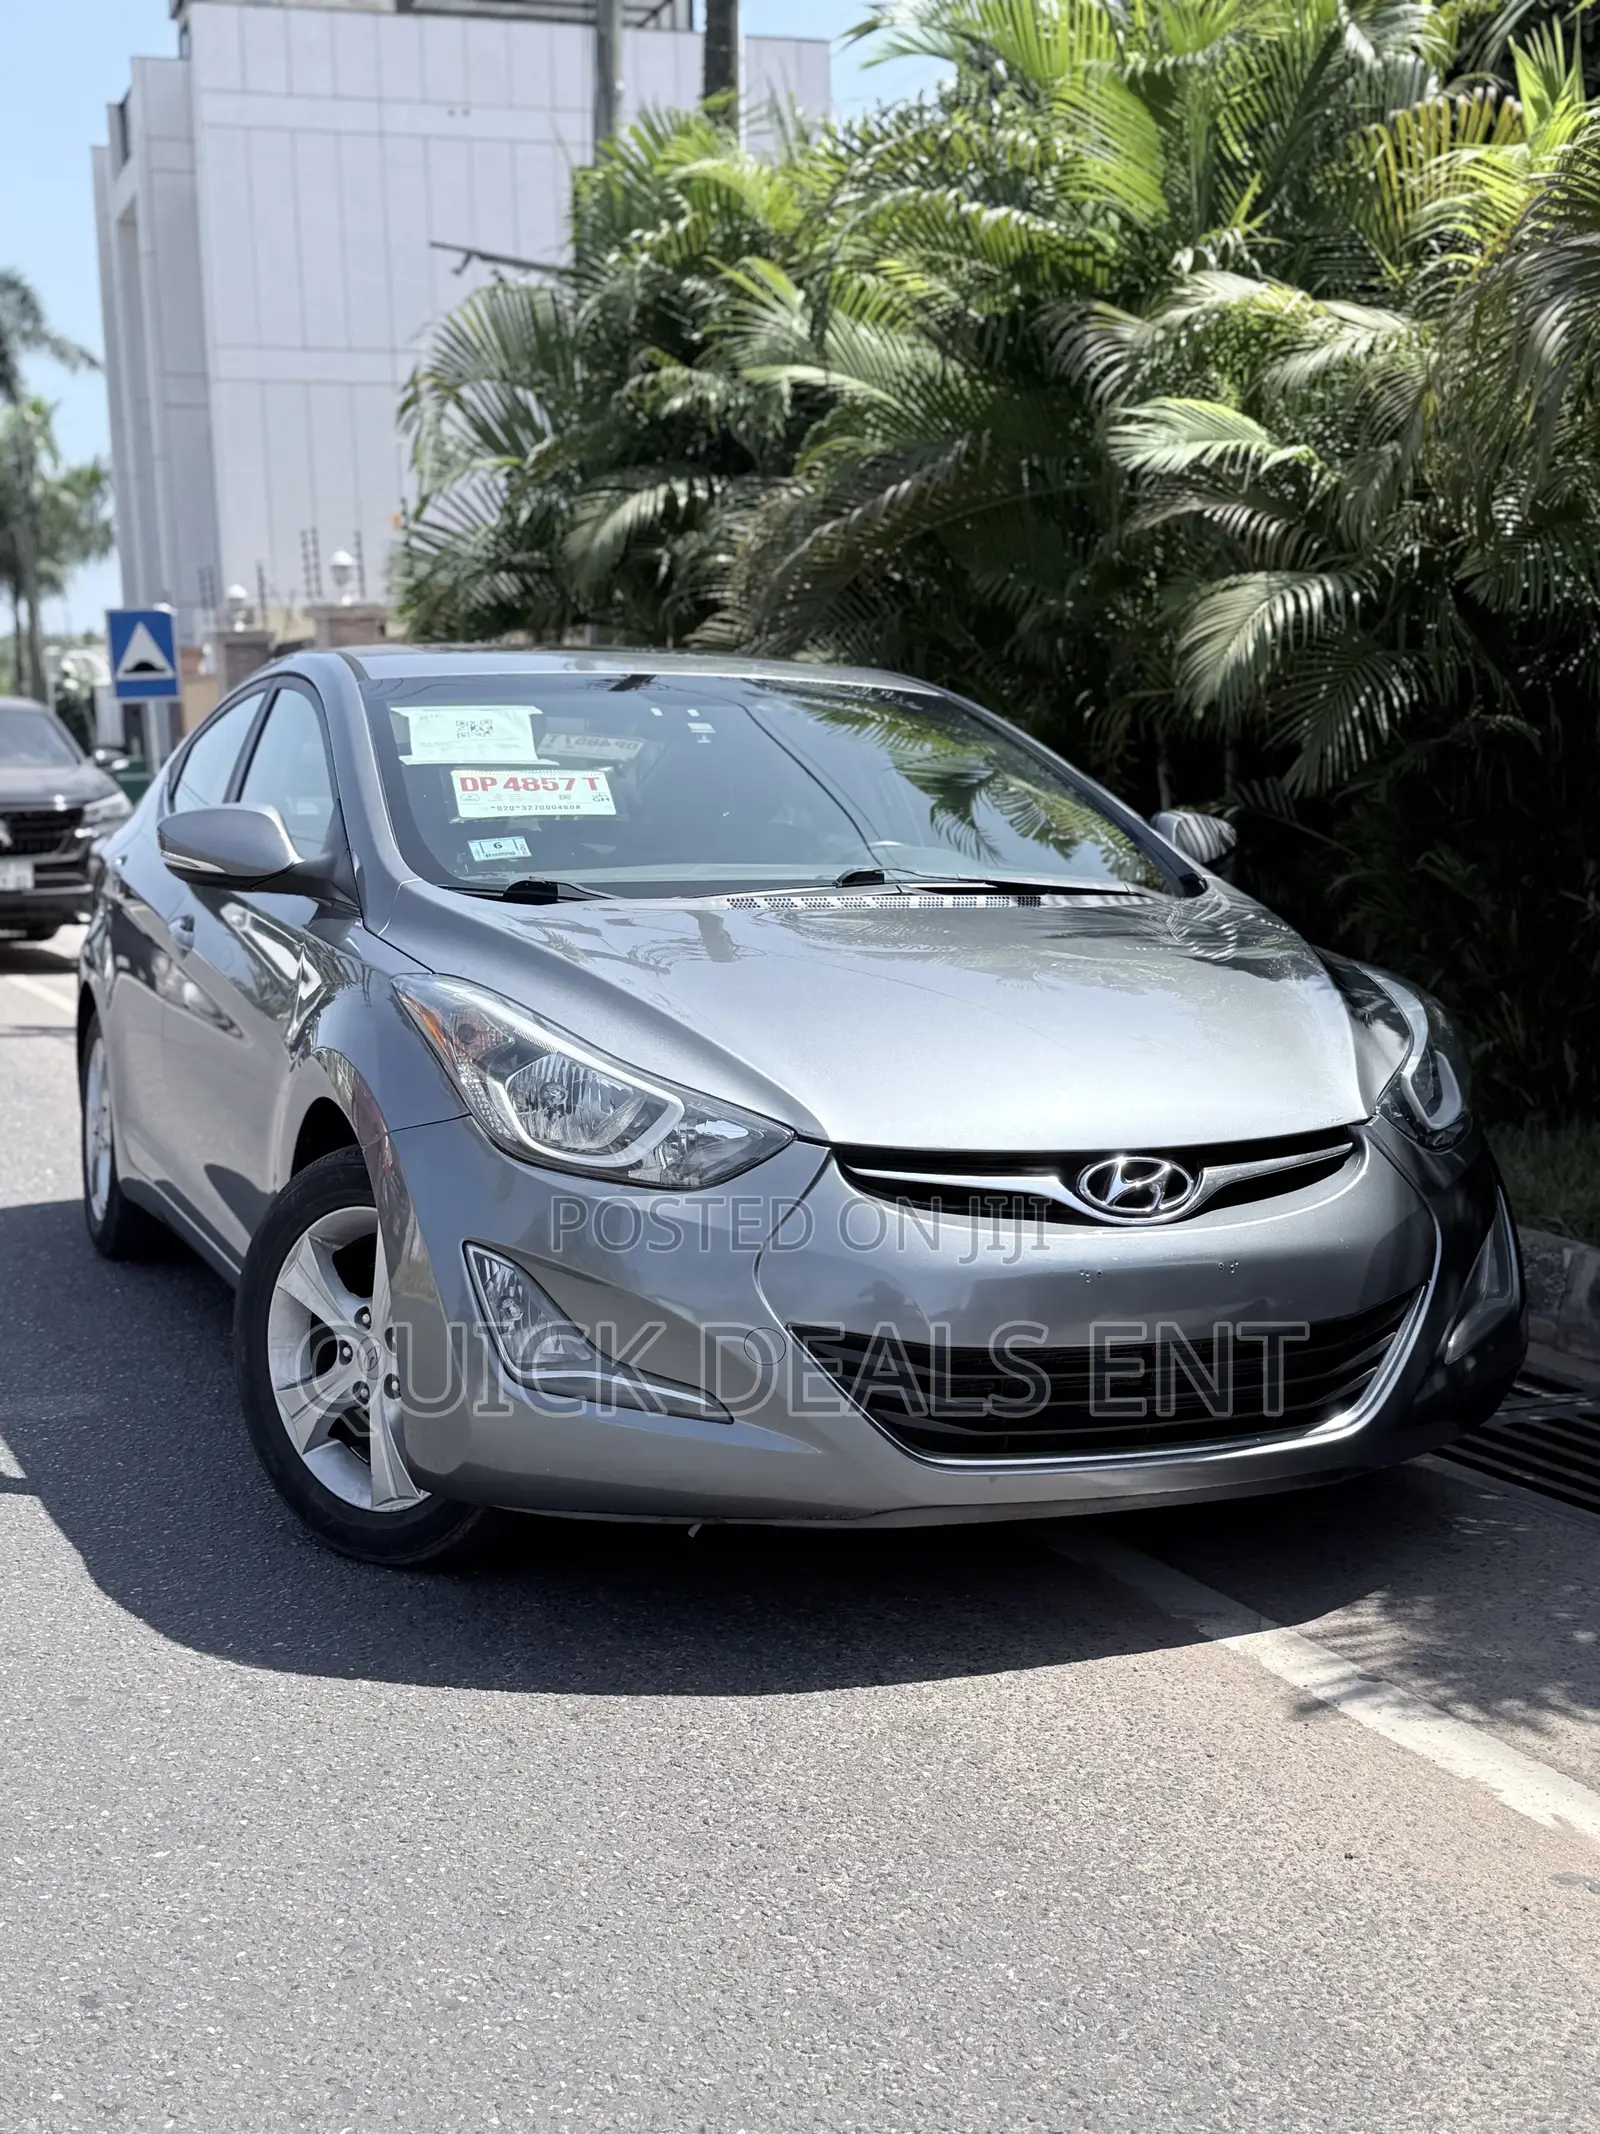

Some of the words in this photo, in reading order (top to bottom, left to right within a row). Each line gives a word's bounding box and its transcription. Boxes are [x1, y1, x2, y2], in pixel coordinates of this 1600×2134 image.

[459, 777, 498, 792] DP
[502, 777, 576, 792] 4857
[581, 777, 600, 791] T
[493, 841, 503, 850] 6
